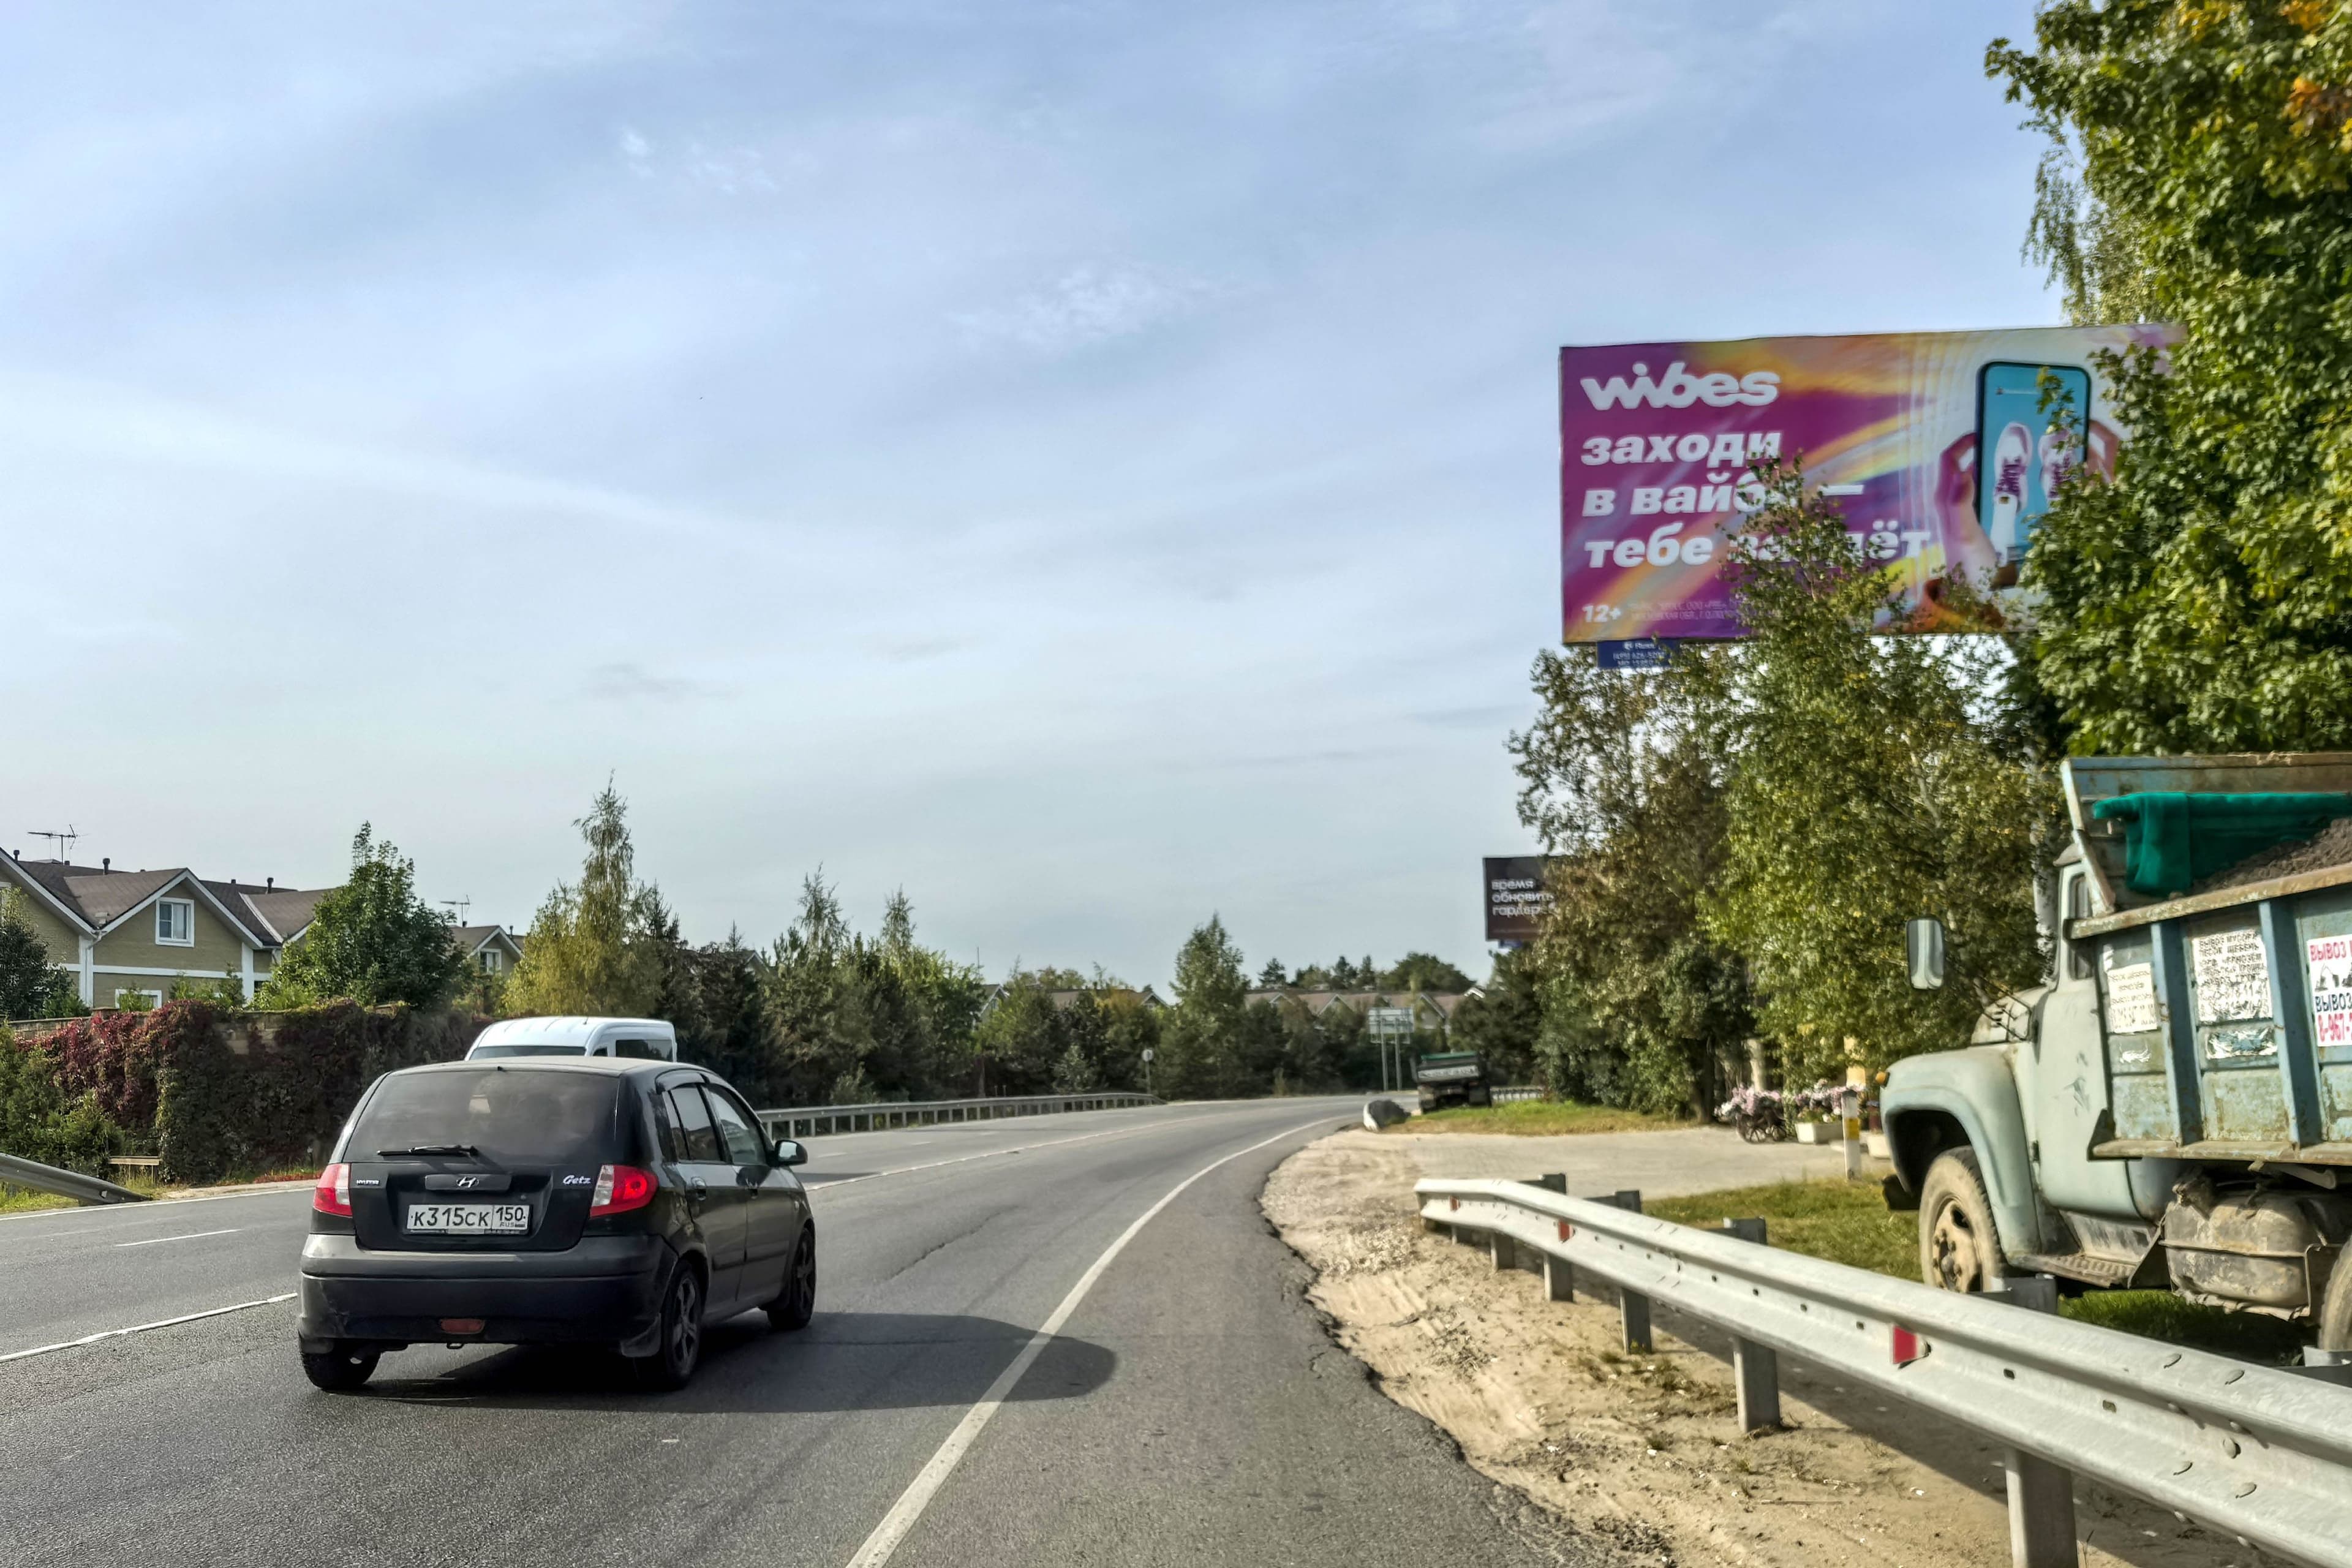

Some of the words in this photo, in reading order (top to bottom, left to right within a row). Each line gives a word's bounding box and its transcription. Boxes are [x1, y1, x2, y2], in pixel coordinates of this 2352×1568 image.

[1580, 361, 1781, 410] wibes
[1581, 432, 1781, 468] заходи
[1582, 489, 1616, 517] в
[1585, 522, 1713, 568] тебе
[1583, 603, 1622, 623] 12+
[1492, 878, 1534, 892] время
[2310, 941, 2346, 962] ВЫВОЗ
[2315, 992, 2352, 1012] ВЫВОЗ
[2318, 1012, 2352, 1042] 8-967-
[563, 1175, 591, 1185] Getz
[496, 1207, 524, 1221] 150
